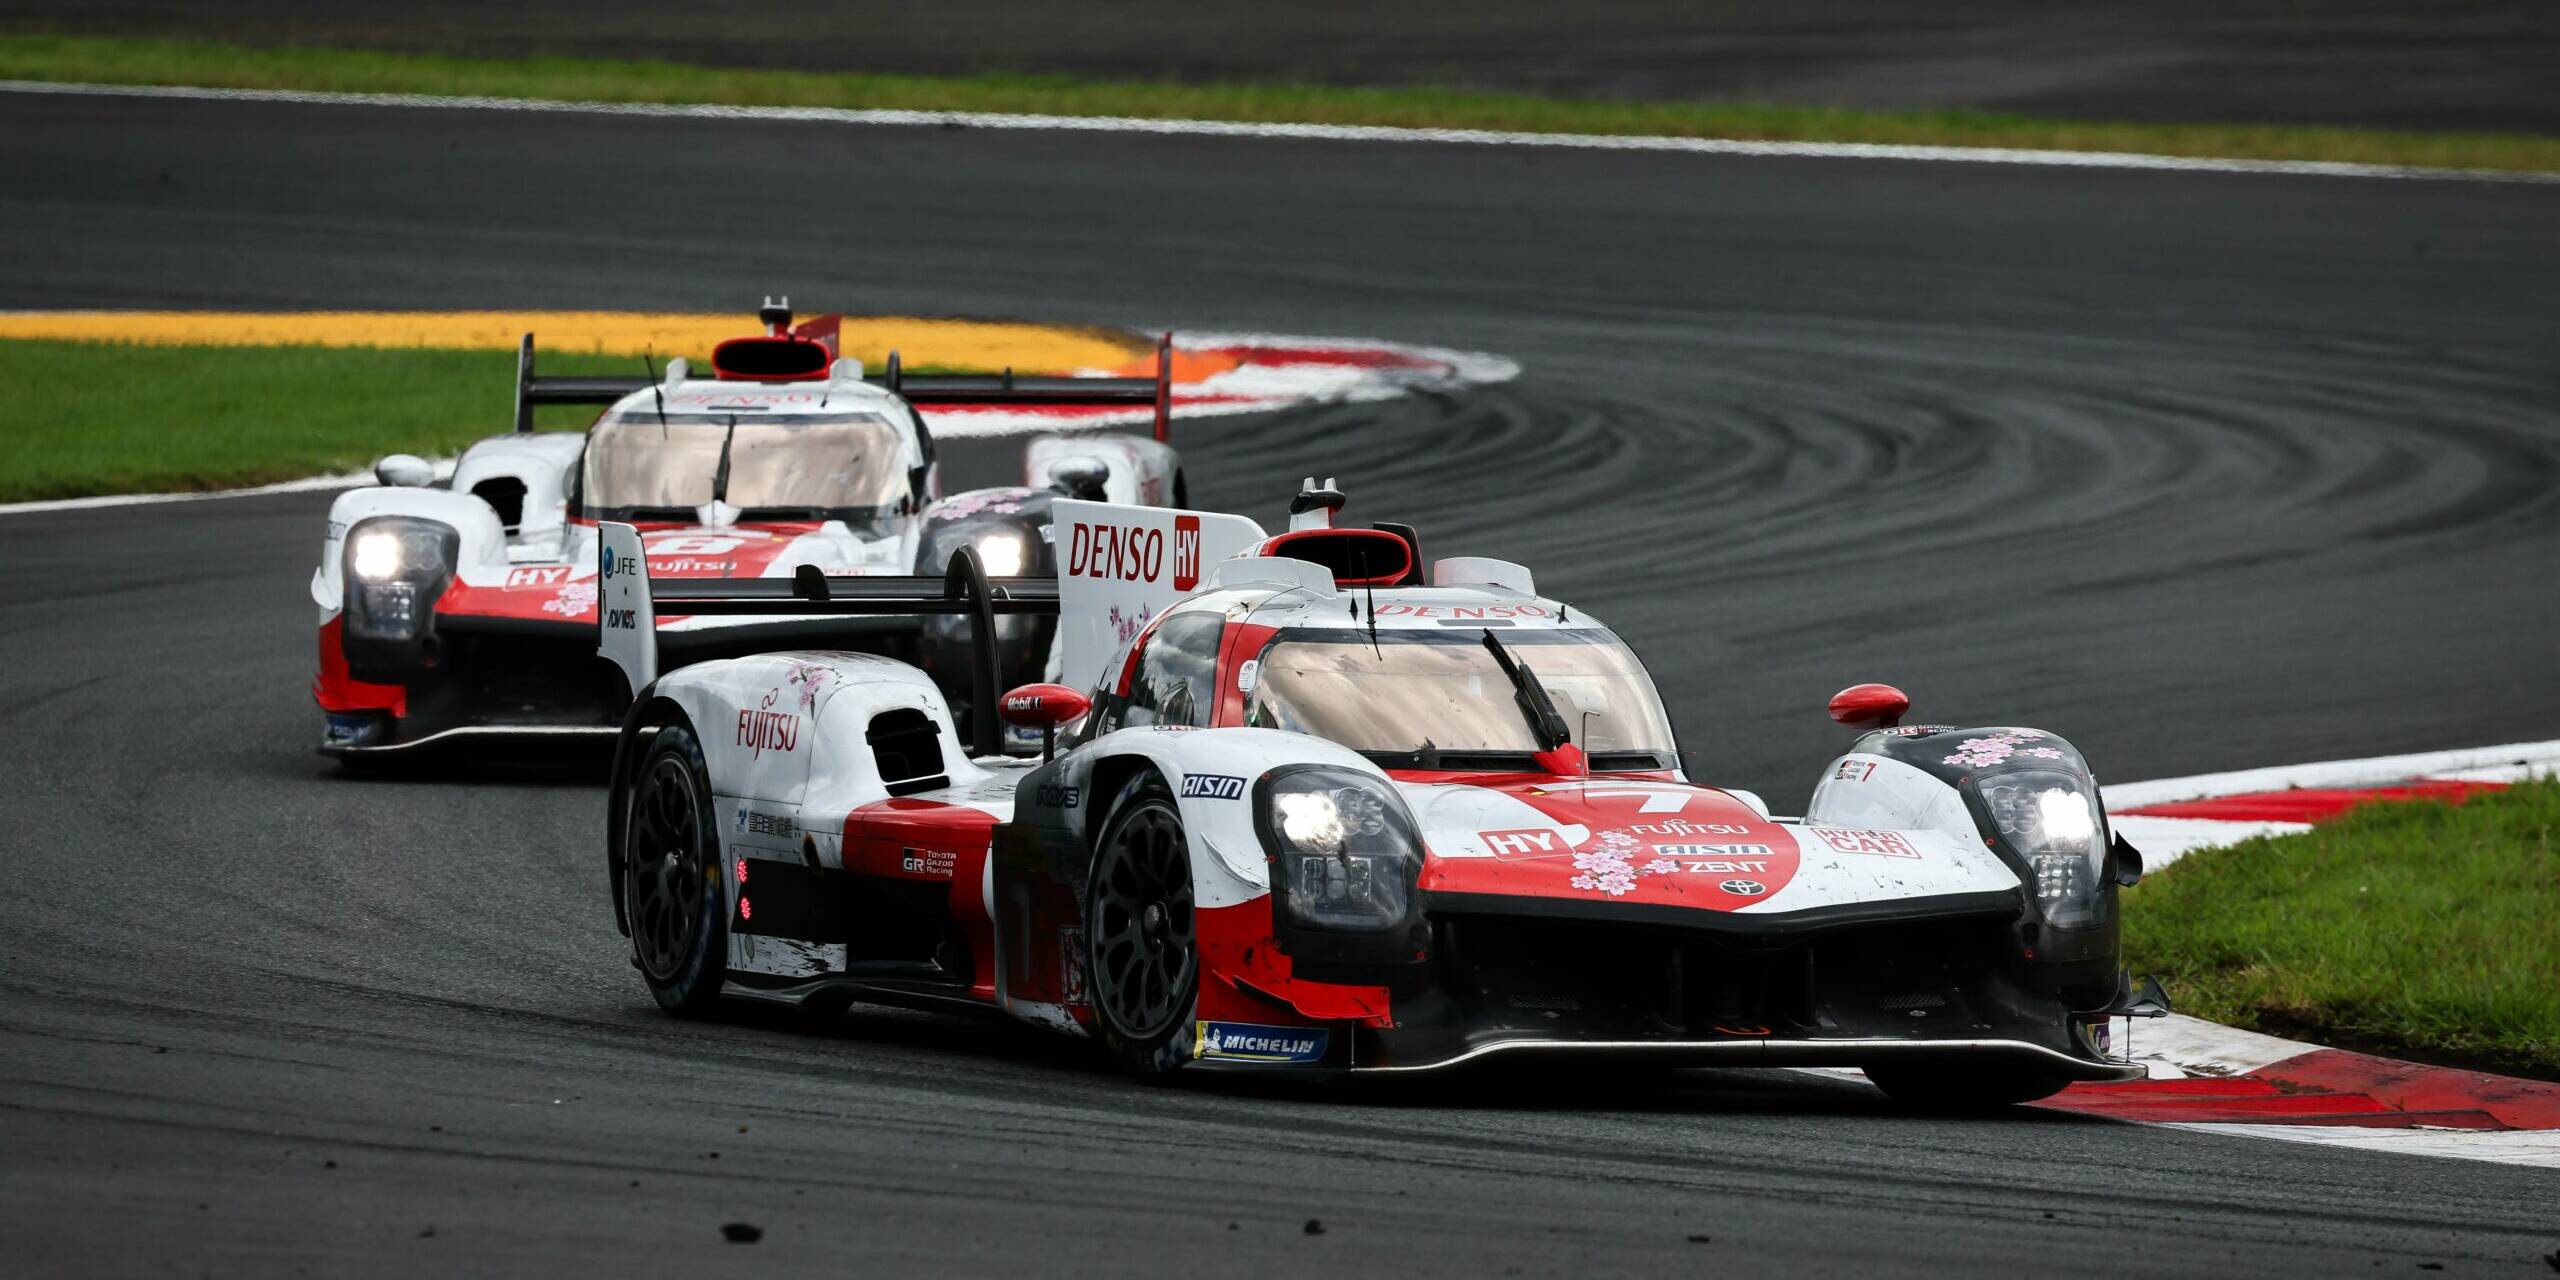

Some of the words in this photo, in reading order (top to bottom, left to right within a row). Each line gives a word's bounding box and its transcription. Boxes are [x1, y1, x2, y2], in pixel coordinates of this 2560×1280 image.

[645, 536, 745, 555] 8
[1069, 523, 1162, 583] DENSO
[1175, 530, 1198, 578] HY
[615, 557, 636, 576] JFE
[510, 569, 567, 586] HY
[1375, 604, 1548, 618] DENSO
[1008, 697, 1031, 710] Mobil
[736, 709, 800, 761] FUJITSU
[1861, 762, 1877, 782] 7
[1181, 775, 1244, 798] AISIN
[1584, 792, 1692, 813] 7
[1629, 820, 1750, 836] FUJITSU
[1818, 829, 1898, 841] HYPER
[1487, 832, 1553, 855] HY
[1659, 845, 1768, 855] AISIN
[1830, 837, 1912, 855] CAR
[904, 857, 924, 871] GR
[926, 858, 954, 867] GAZOO
[1685, 861, 1767, 873] ZENT
[926, 866, 953, 877] Racing
[1223, 1035, 1315, 1053] MICHELIN
